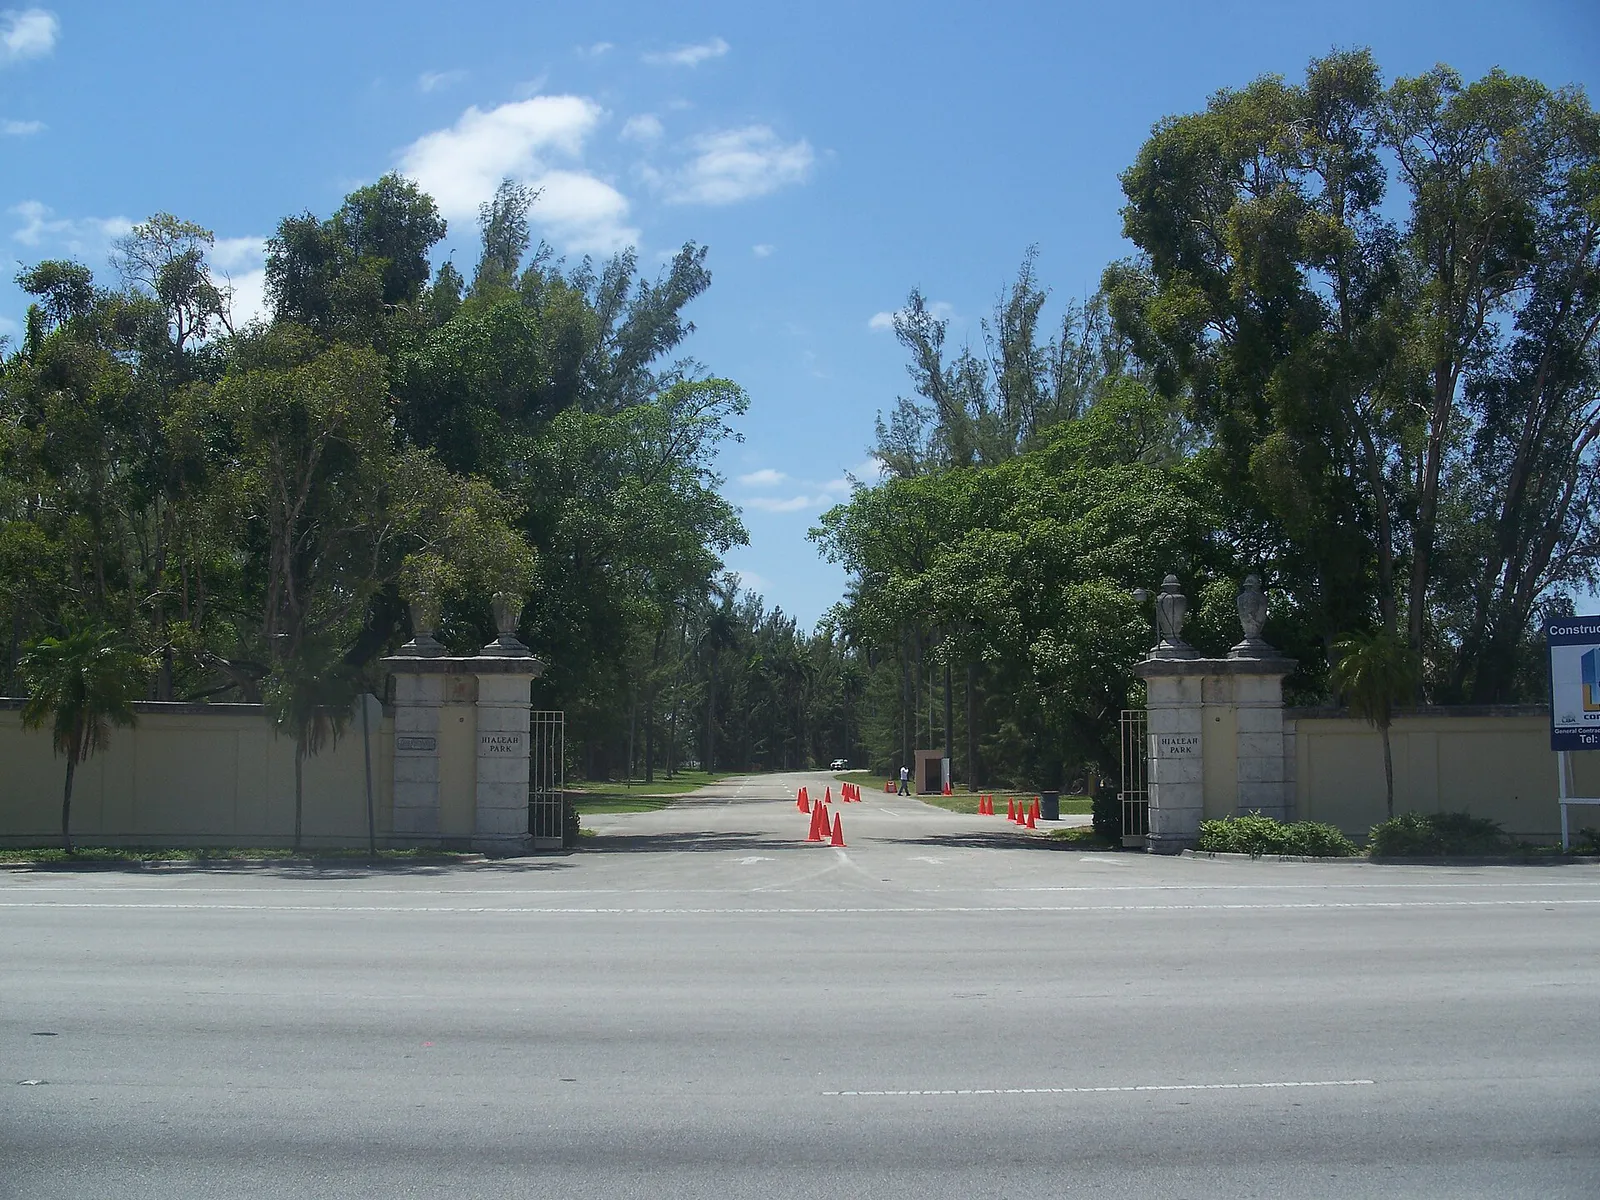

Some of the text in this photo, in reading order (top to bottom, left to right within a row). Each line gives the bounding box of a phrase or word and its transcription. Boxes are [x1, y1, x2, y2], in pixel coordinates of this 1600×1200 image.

[481, 736, 519, 744] HIALEAH
[1161, 737, 1198, 745] HIALEAH
[1579, 734, 1598, 743] Tel:
